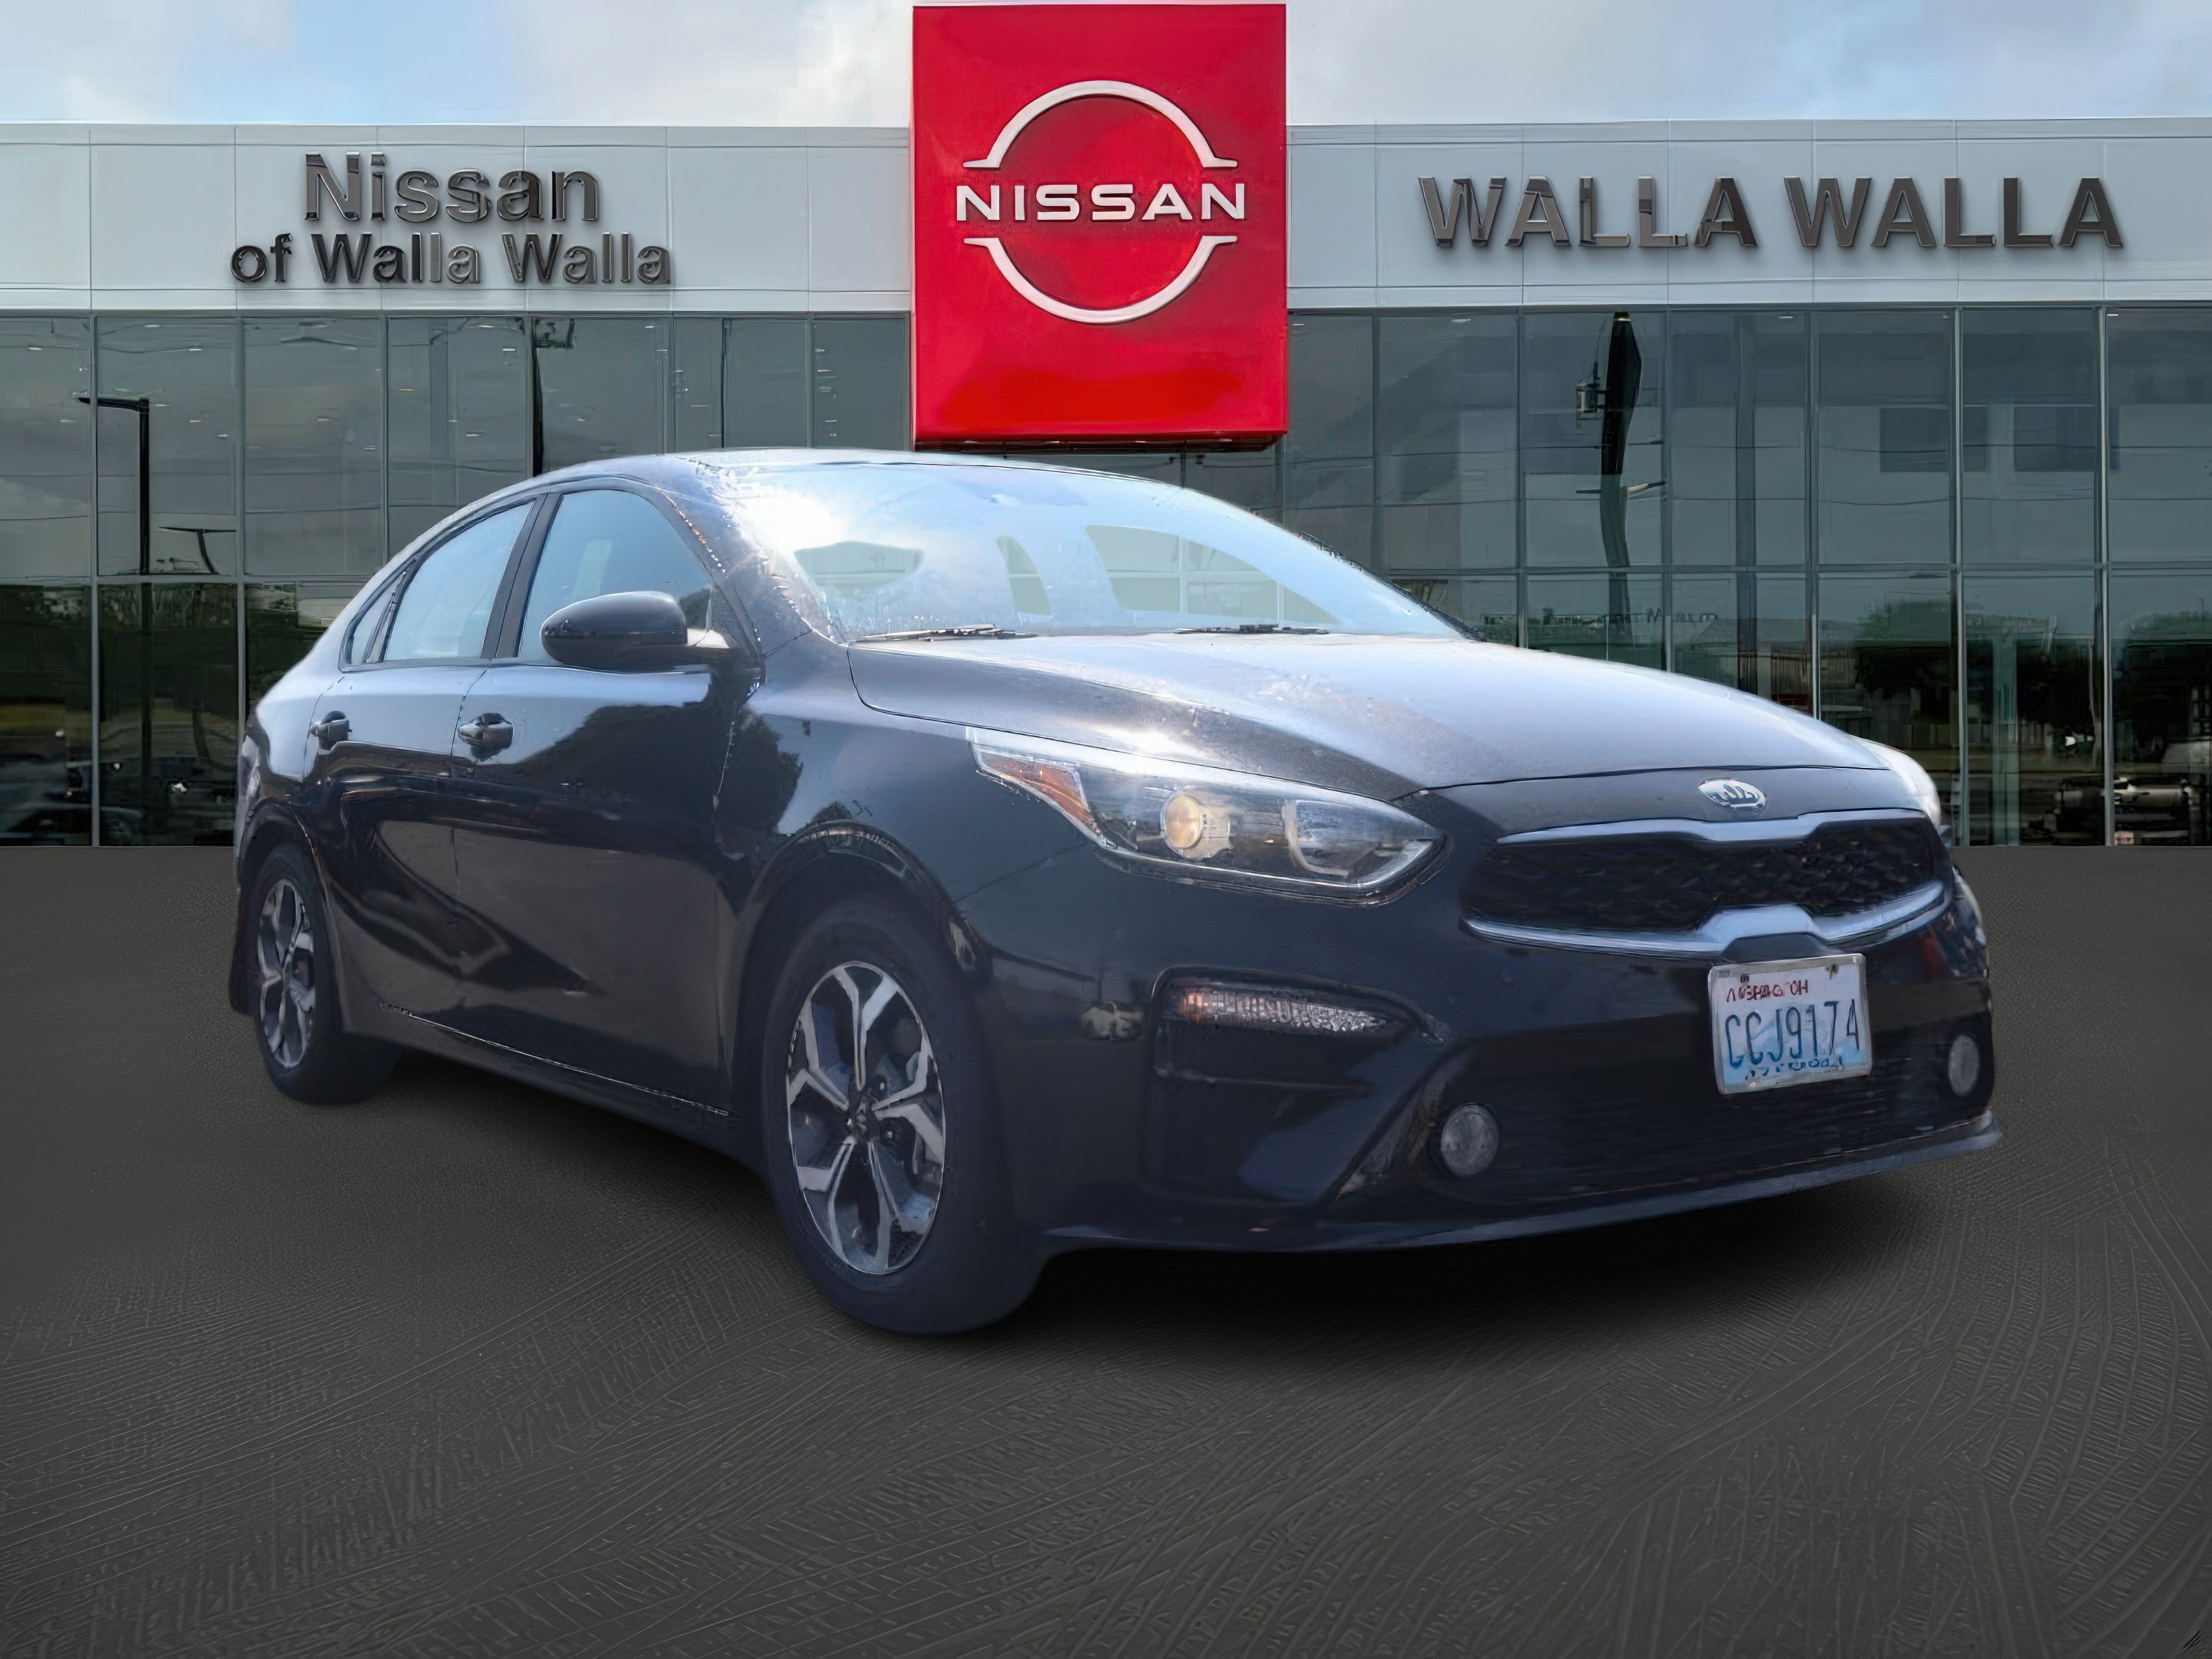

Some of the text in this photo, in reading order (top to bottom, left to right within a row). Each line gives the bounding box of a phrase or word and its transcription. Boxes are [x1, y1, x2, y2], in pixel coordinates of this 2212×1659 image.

[304, 151, 601, 224] Nissan
[956, 183, 1246, 221] NISSAN
[1418, 175, 2125, 250] WALLA WALLA
[230, 232, 672, 284] of Walla Walla
